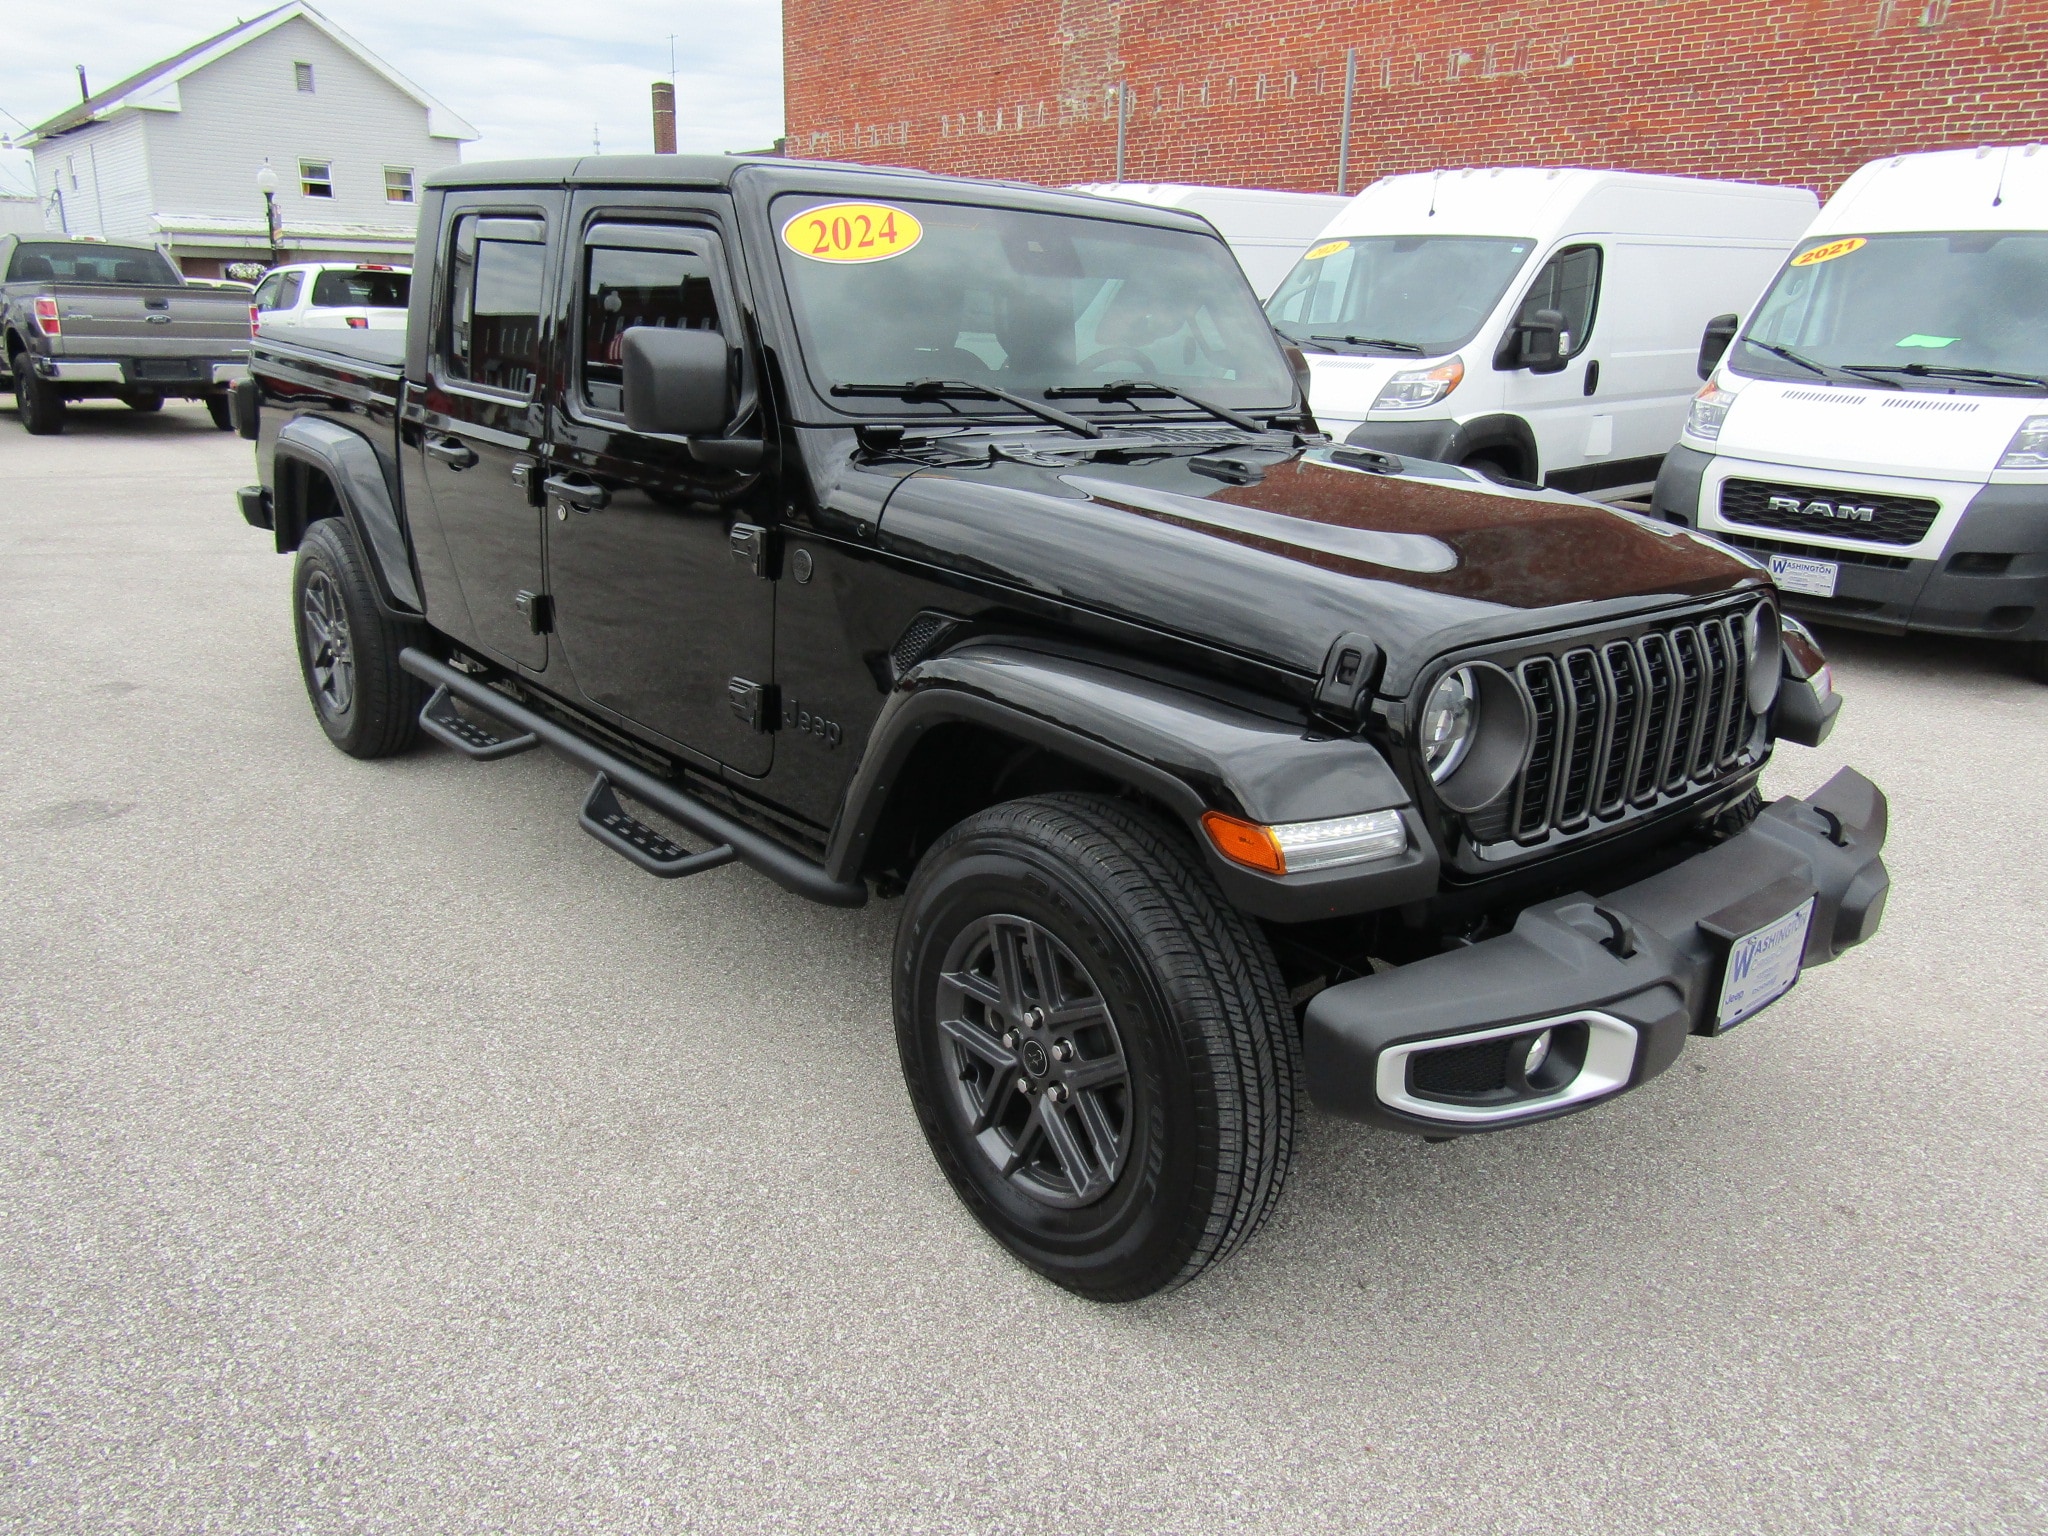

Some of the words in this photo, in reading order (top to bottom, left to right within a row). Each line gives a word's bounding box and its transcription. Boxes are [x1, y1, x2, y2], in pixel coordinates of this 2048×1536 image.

[809, 211, 897, 254] 2024
[1799, 240, 1856, 264] 2021
[1768, 496, 1875, 522] RAM
[1773, 559, 1832, 574] WASHINGTON
[781, 699, 843, 749] Jeep
[1733, 912, 1807, 983] WASHINGTON
